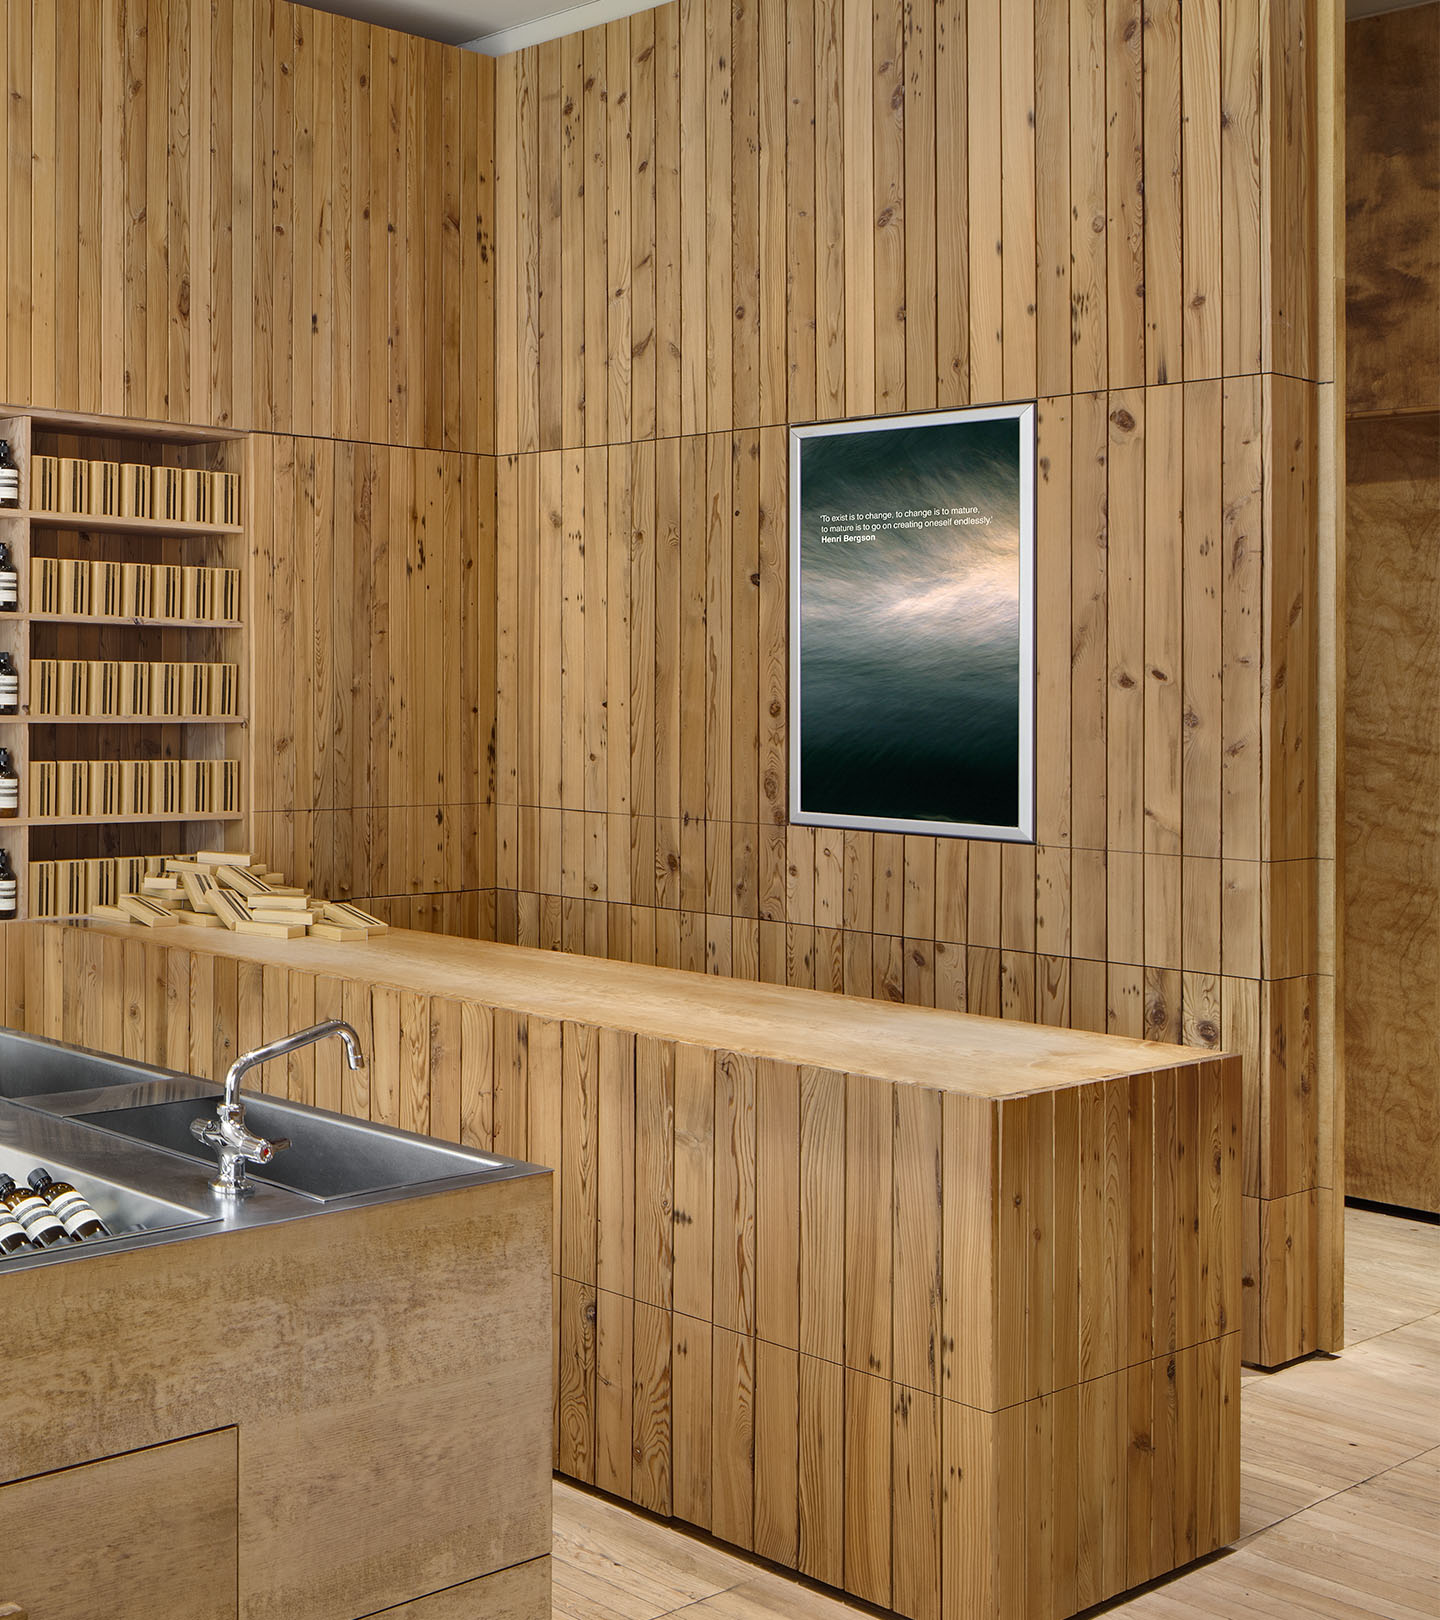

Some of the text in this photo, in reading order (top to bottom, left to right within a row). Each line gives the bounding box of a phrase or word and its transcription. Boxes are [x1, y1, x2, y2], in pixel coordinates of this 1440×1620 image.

[832, 514, 848, 522] exist
[865, 512, 893, 520] change,
[904, 509, 932, 518] change
[951, 506, 980, 514] mature,
[871, 524, 881, 532] go
[893, 521, 922, 529] creating
[924, 518, 952, 527] oneself
[844, 534, 876, 543] Bergson
